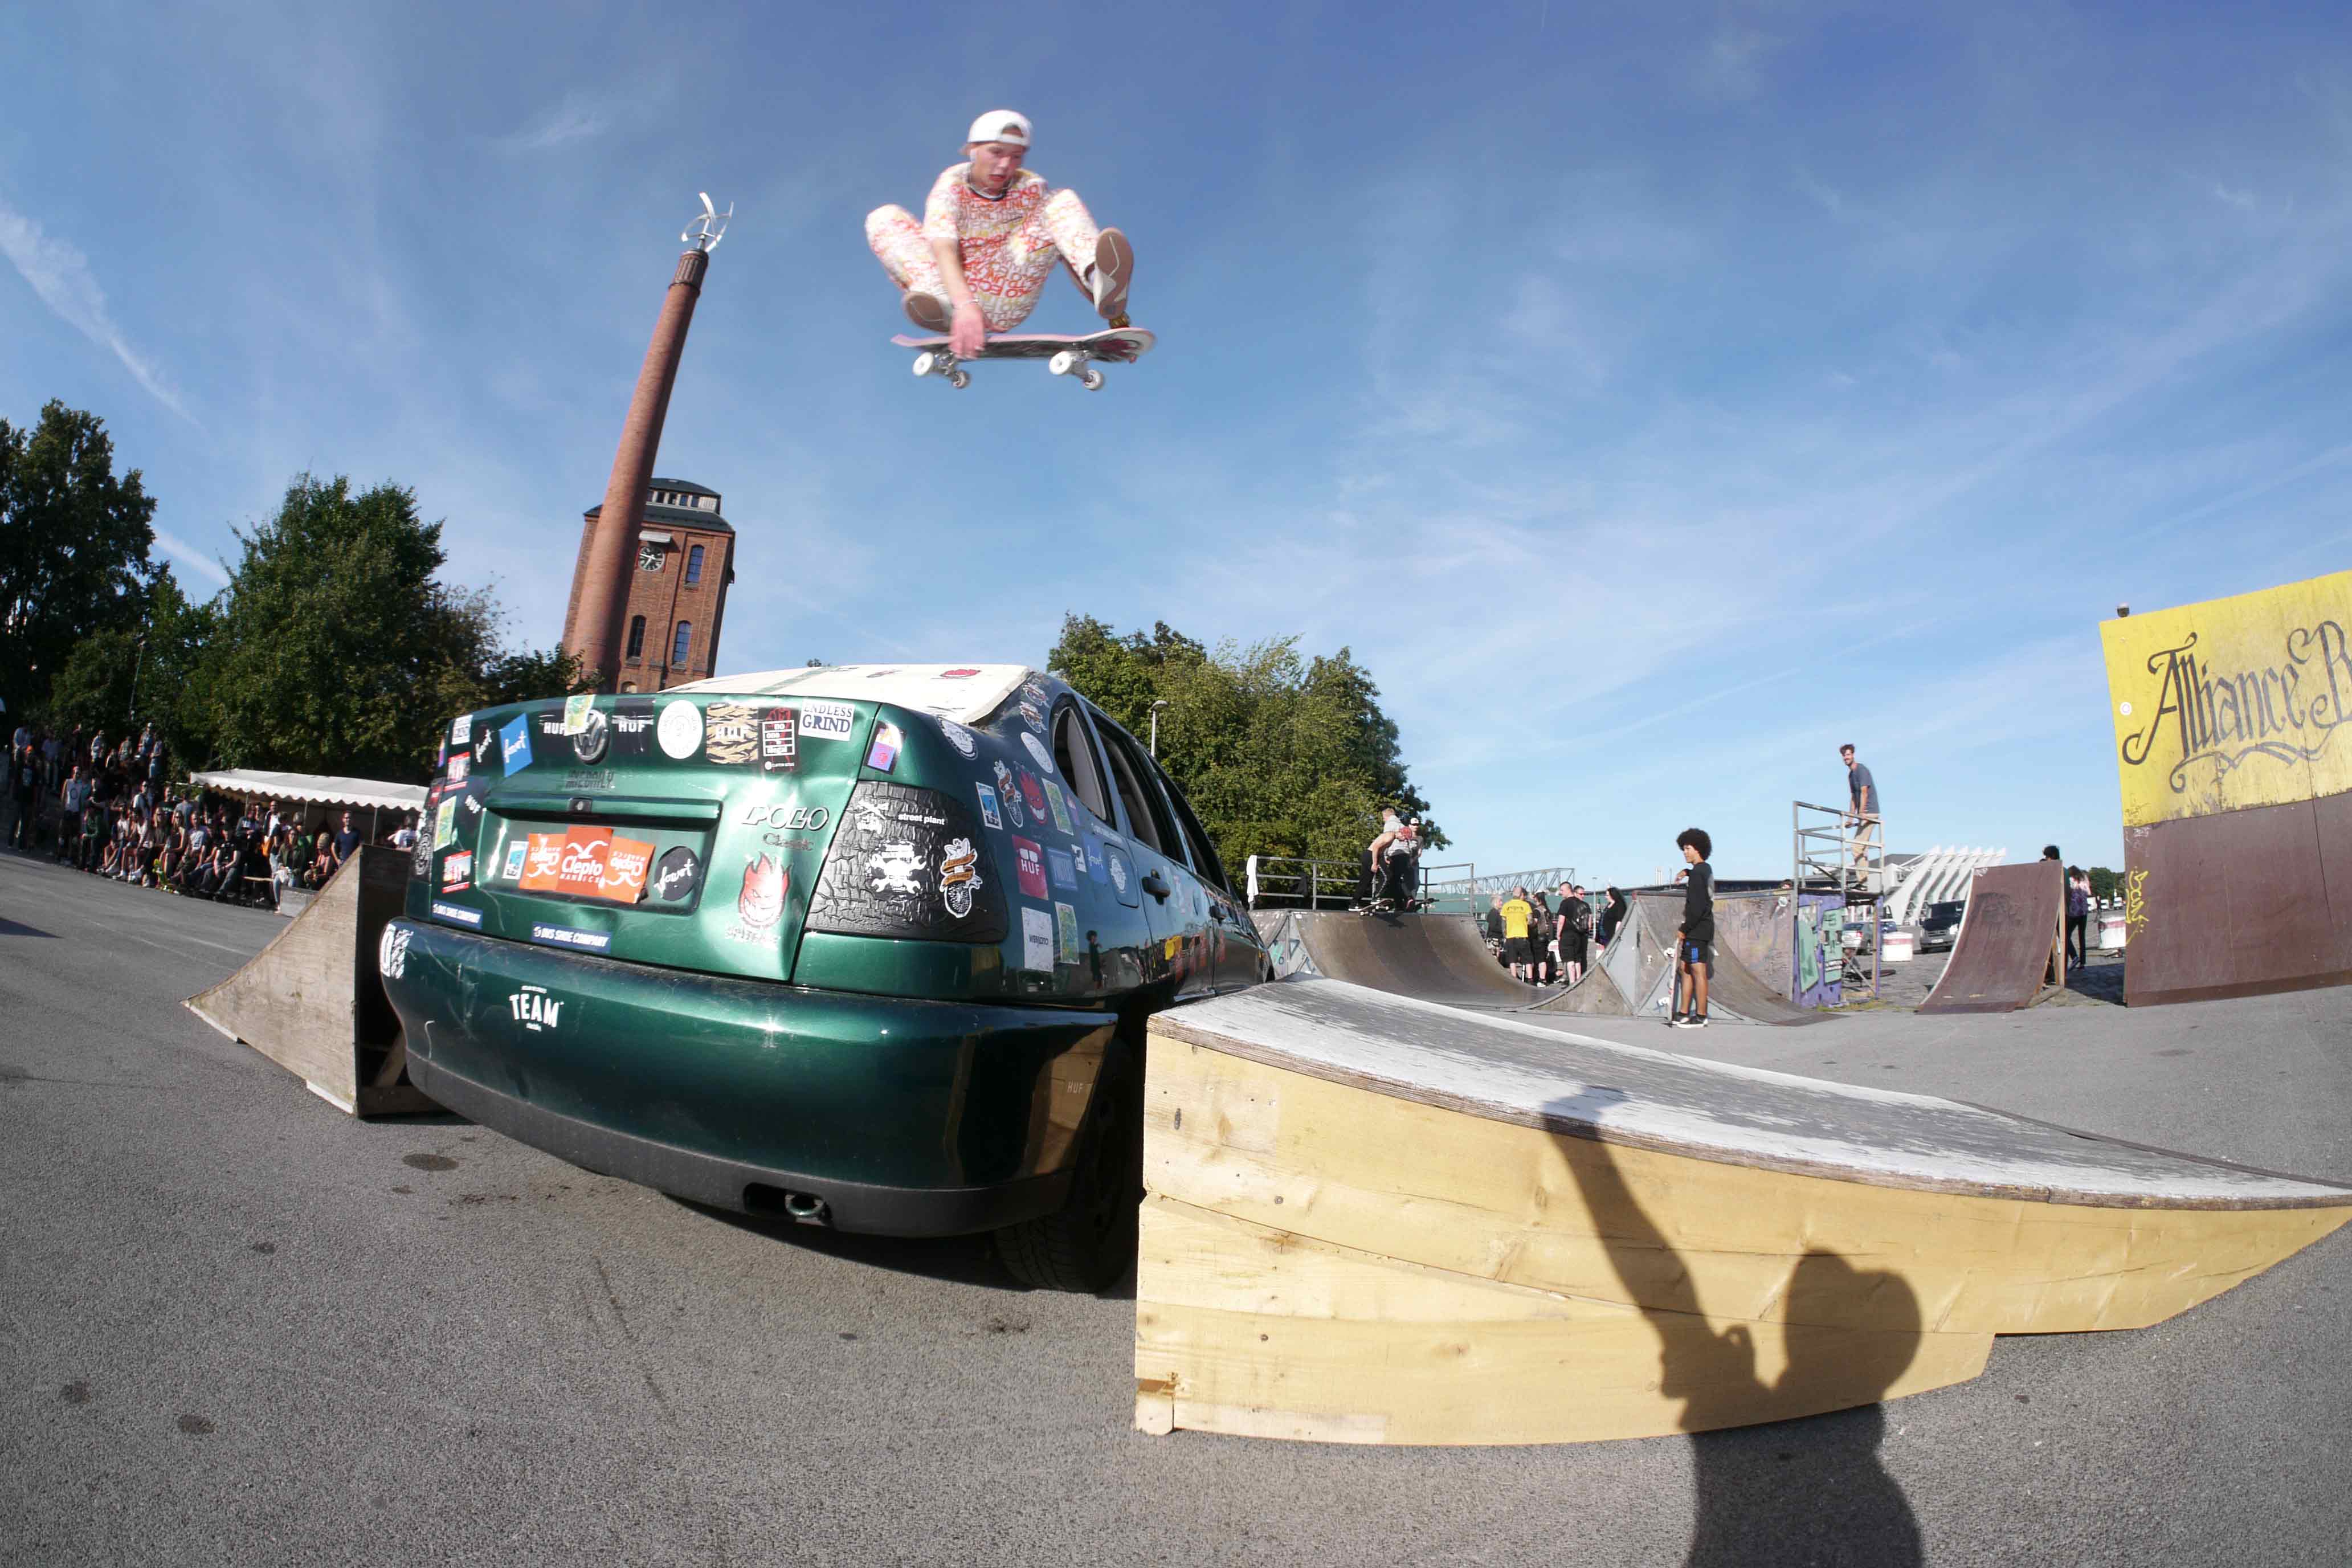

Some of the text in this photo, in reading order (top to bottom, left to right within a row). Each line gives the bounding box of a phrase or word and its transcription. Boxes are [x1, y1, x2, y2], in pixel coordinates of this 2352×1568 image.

[803, 701, 853, 717] ENDLESS
[617, 720, 646, 733] HUF
[802, 714, 851, 733] GRIND
[716, 726, 752, 740] HUF
[741, 806, 830, 832] POLO
[897, 812, 945, 826] street plant
[561, 855, 603, 881] Clepto
[1020, 859, 1040, 876] HUF
[508, 993, 560, 1028] TEAM
[1067, 1081, 1085, 1095] HUF
